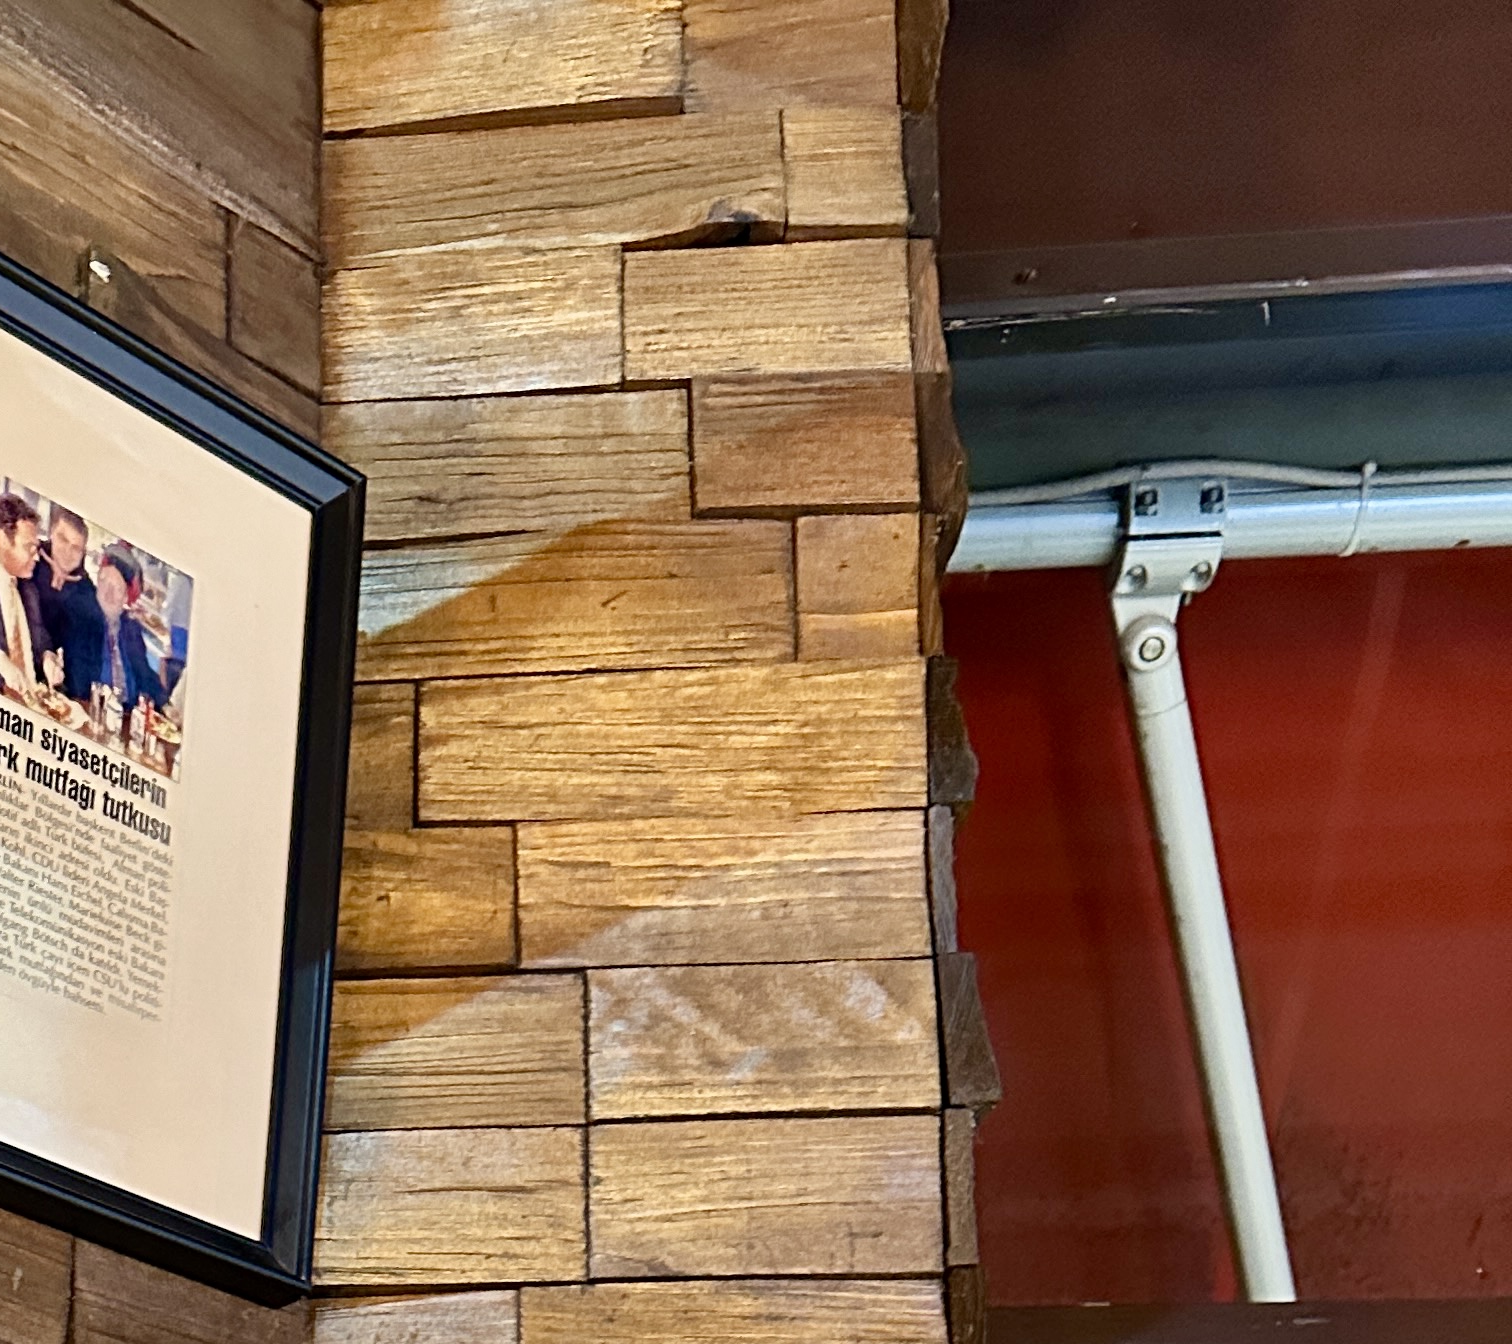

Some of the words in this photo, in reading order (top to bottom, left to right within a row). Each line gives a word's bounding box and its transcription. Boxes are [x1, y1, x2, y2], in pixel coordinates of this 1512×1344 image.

[25, 756, 95, 811] mutfağı
[102, 790, 171, 846] tutkusu
[40, 728, 166, 809] siyasetçilerin
